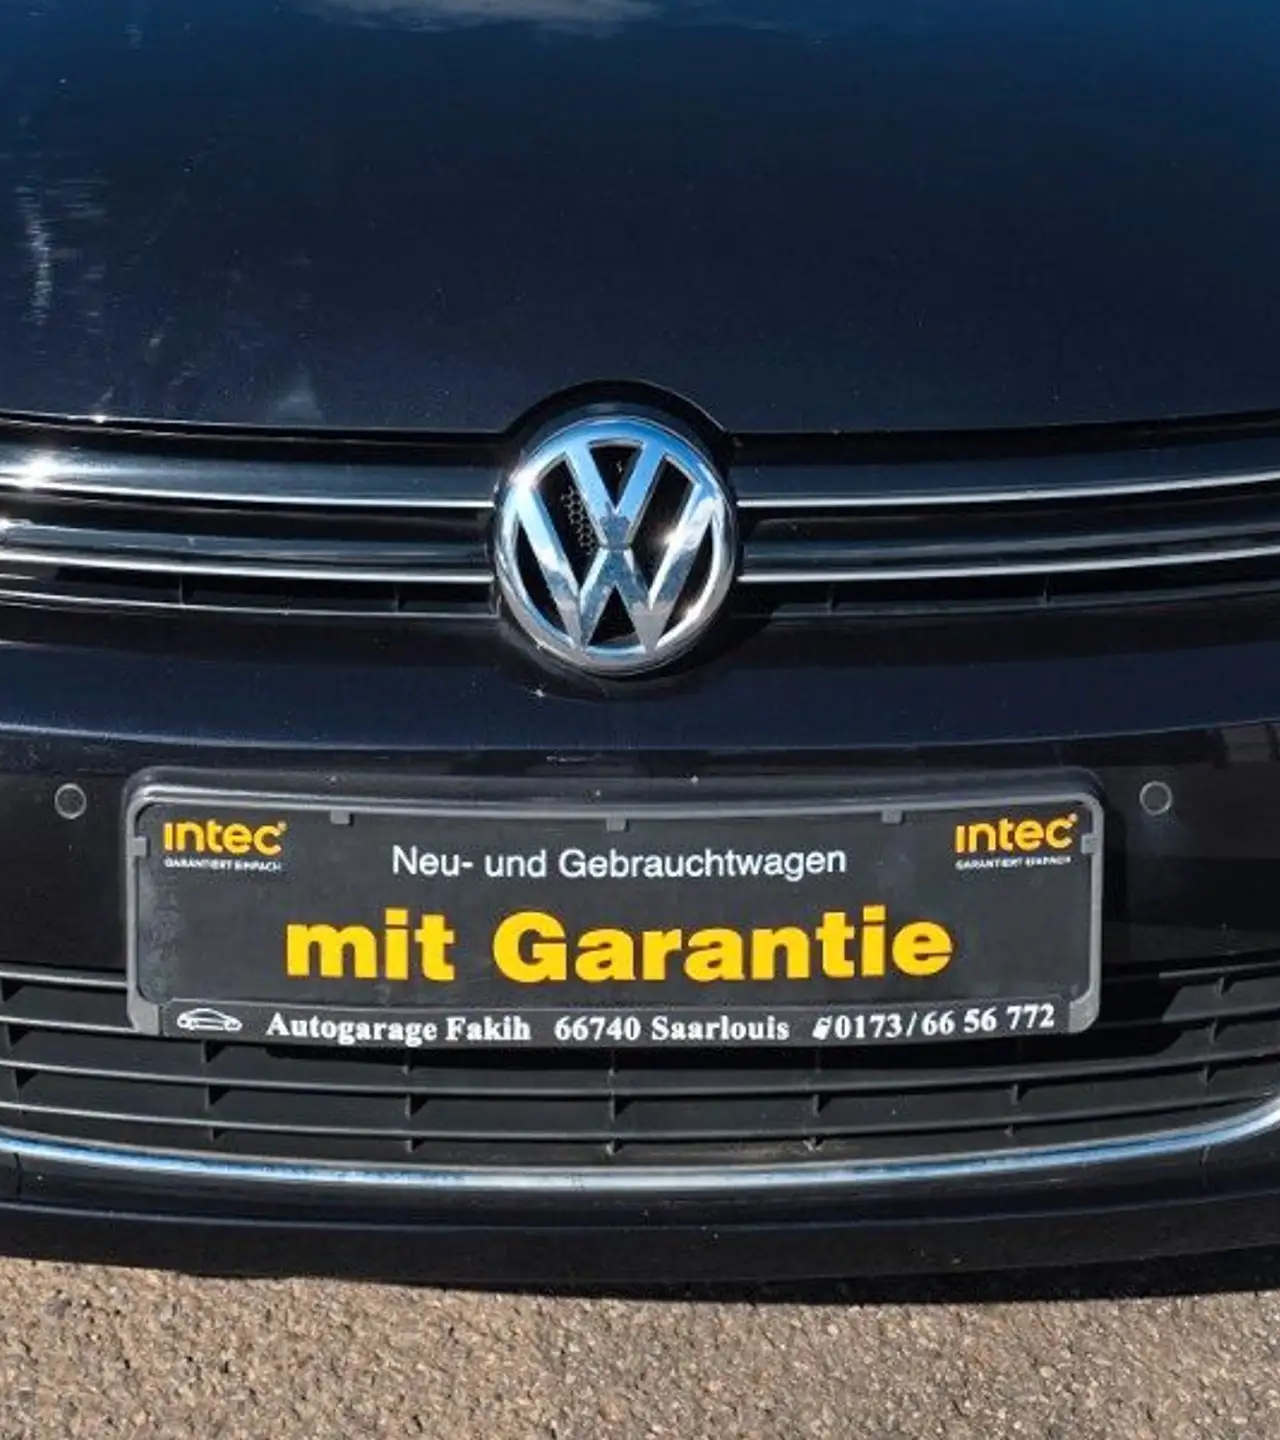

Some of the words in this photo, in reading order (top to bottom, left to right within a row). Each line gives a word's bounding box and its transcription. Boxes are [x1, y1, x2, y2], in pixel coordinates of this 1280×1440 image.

[392, 844, 474, 877] Neu-
[485, 848, 547, 878] und
[558, 846, 847, 883] Gebrauchtwagen
[284, 906, 457, 982] mit
[491, 903, 954, 985] Garantie
[266, 1012, 438, 1048] Autogarage
[444, 1016, 532, 1042] Fakih
[553, 1015, 642, 1042] 66740
[651, 1014, 790, 1042] Saarlouis
[963, 1006, 998, 1034] 56
[1006, 1002, 1055, 1031] 772
